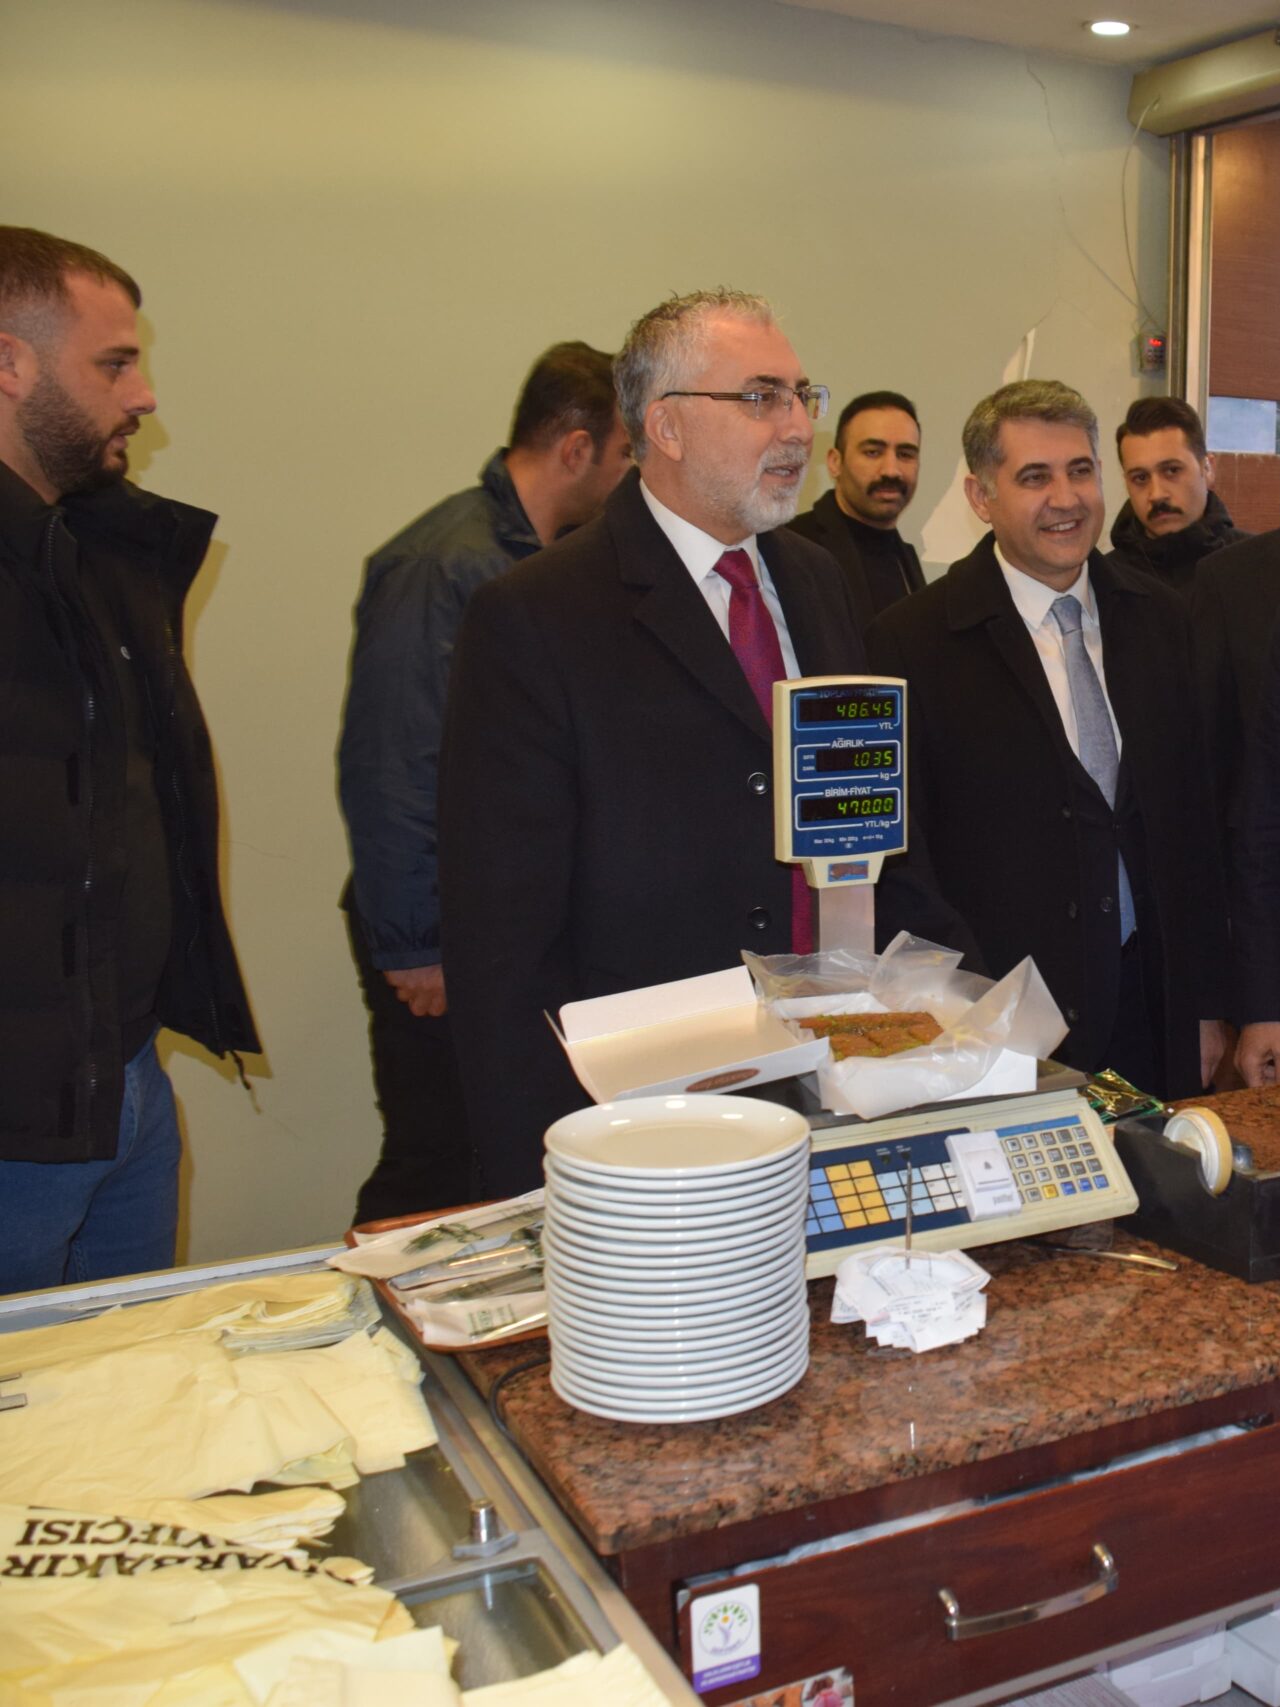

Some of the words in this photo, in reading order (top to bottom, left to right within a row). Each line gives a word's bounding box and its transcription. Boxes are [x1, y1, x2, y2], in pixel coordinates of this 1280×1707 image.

[878, 721, 894, 730] YTL
[831, 737, 865, 749] AĞIRLIK
[879, 772, 890, 781] kg
[824, 786, 872, 798] BİRİM-FİYAT
[864, 820, 890, 829] YTL/kg
